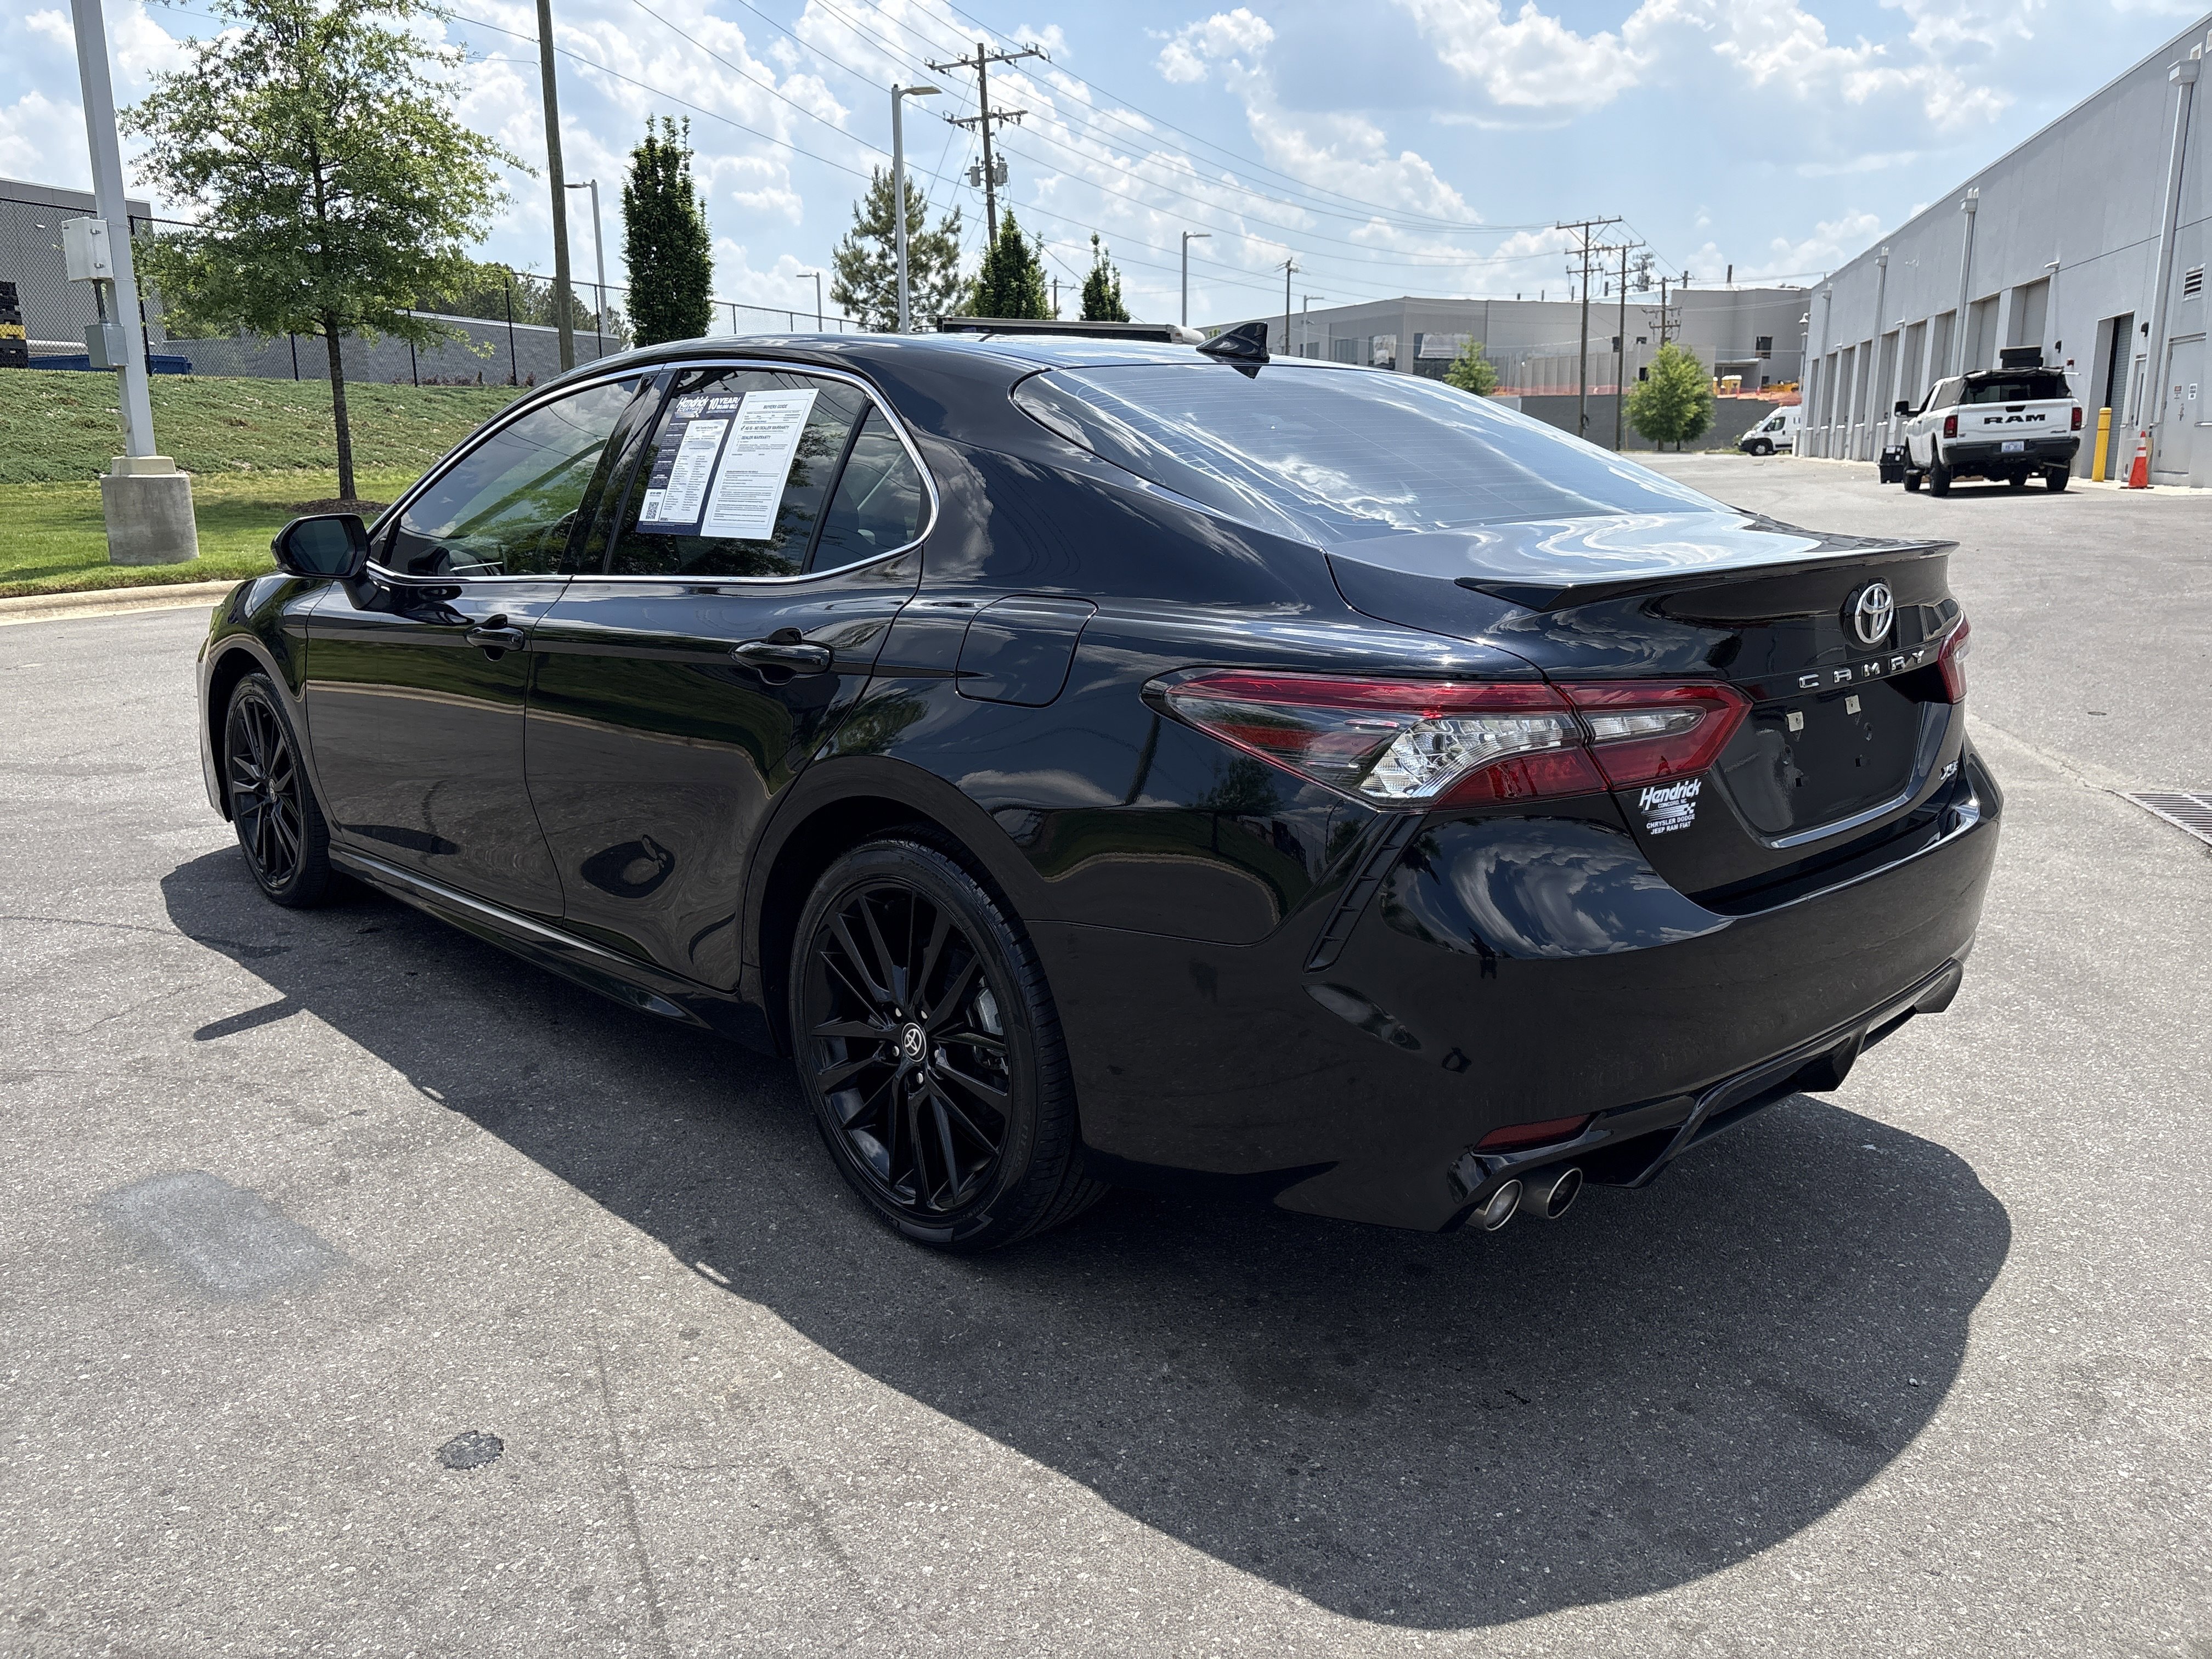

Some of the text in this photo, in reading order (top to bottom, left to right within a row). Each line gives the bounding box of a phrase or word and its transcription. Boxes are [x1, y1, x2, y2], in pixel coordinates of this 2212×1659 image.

[708, 398, 719, 410] 10
[1984, 414, 2045, 425] RAM
[1798, 650, 1925, 689] CAMRY
[1639, 778, 1701, 810] Hendrick
[1646, 814, 1695, 829] CHRYSLER DODGE
[1667, 823, 1679, 832] RAM
[1679, 821, 1691, 829] FIAT
